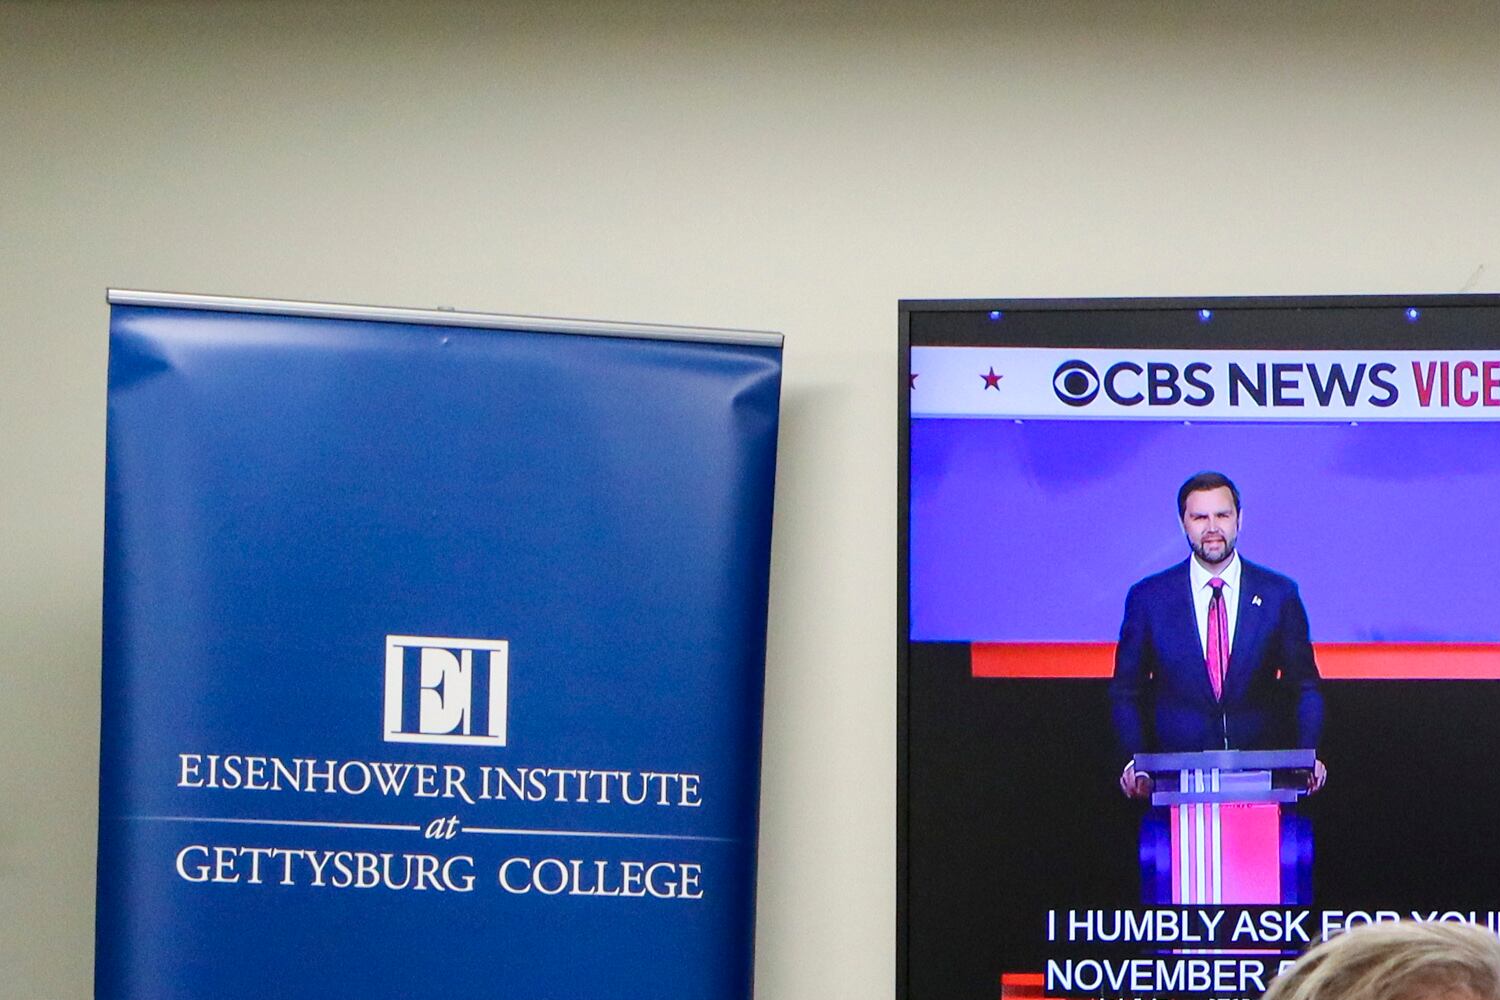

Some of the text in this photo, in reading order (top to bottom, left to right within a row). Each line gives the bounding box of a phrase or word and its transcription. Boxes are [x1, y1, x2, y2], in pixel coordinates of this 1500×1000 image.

[1103, 362, 1215, 407] CBS
[1229, 362, 1399, 407] NEWS
[178, 754, 702, 807] EISENHOWER INSTITUTE
[425, 815, 461, 840] at
[176, 845, 703, 899] GETTYSBURG COLLEGE
[1048, 910, 1055, 941] I
[1070, 910, 1225, 941] HUMBLY
[1231, 910, 1310, 942] ASK
[1047, 959, 1266, 992] NOVEMBER
